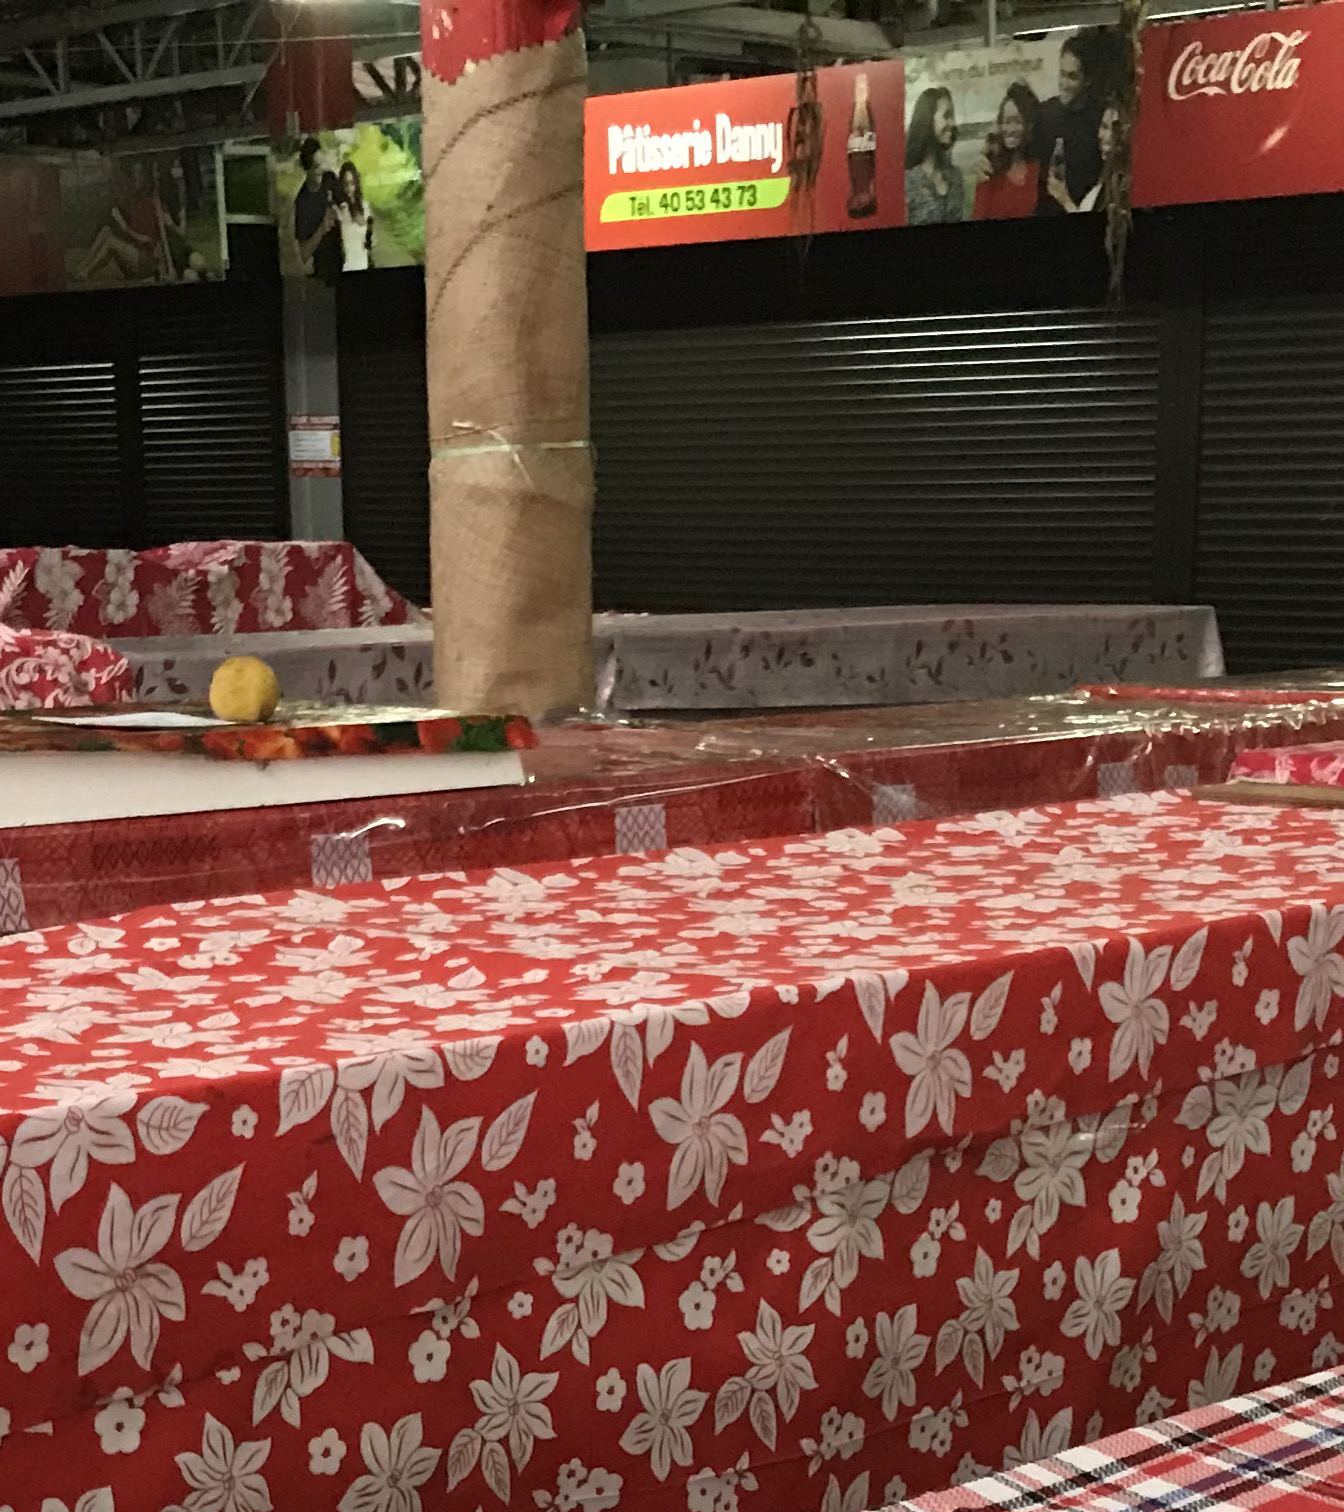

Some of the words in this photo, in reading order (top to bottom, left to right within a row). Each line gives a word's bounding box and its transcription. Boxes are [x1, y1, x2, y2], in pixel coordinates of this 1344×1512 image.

[1168, 30, 1311, 100] Coca-Cola
[608, 119, 712, 174] Pâtisserie
[715, 112, 783, 173] Danny
[659, 191, 681, 213] 40
[685, 189, 706, 211] 53
[710, 186, 732, 208] 43
[737, 184, 757, 206] 73
